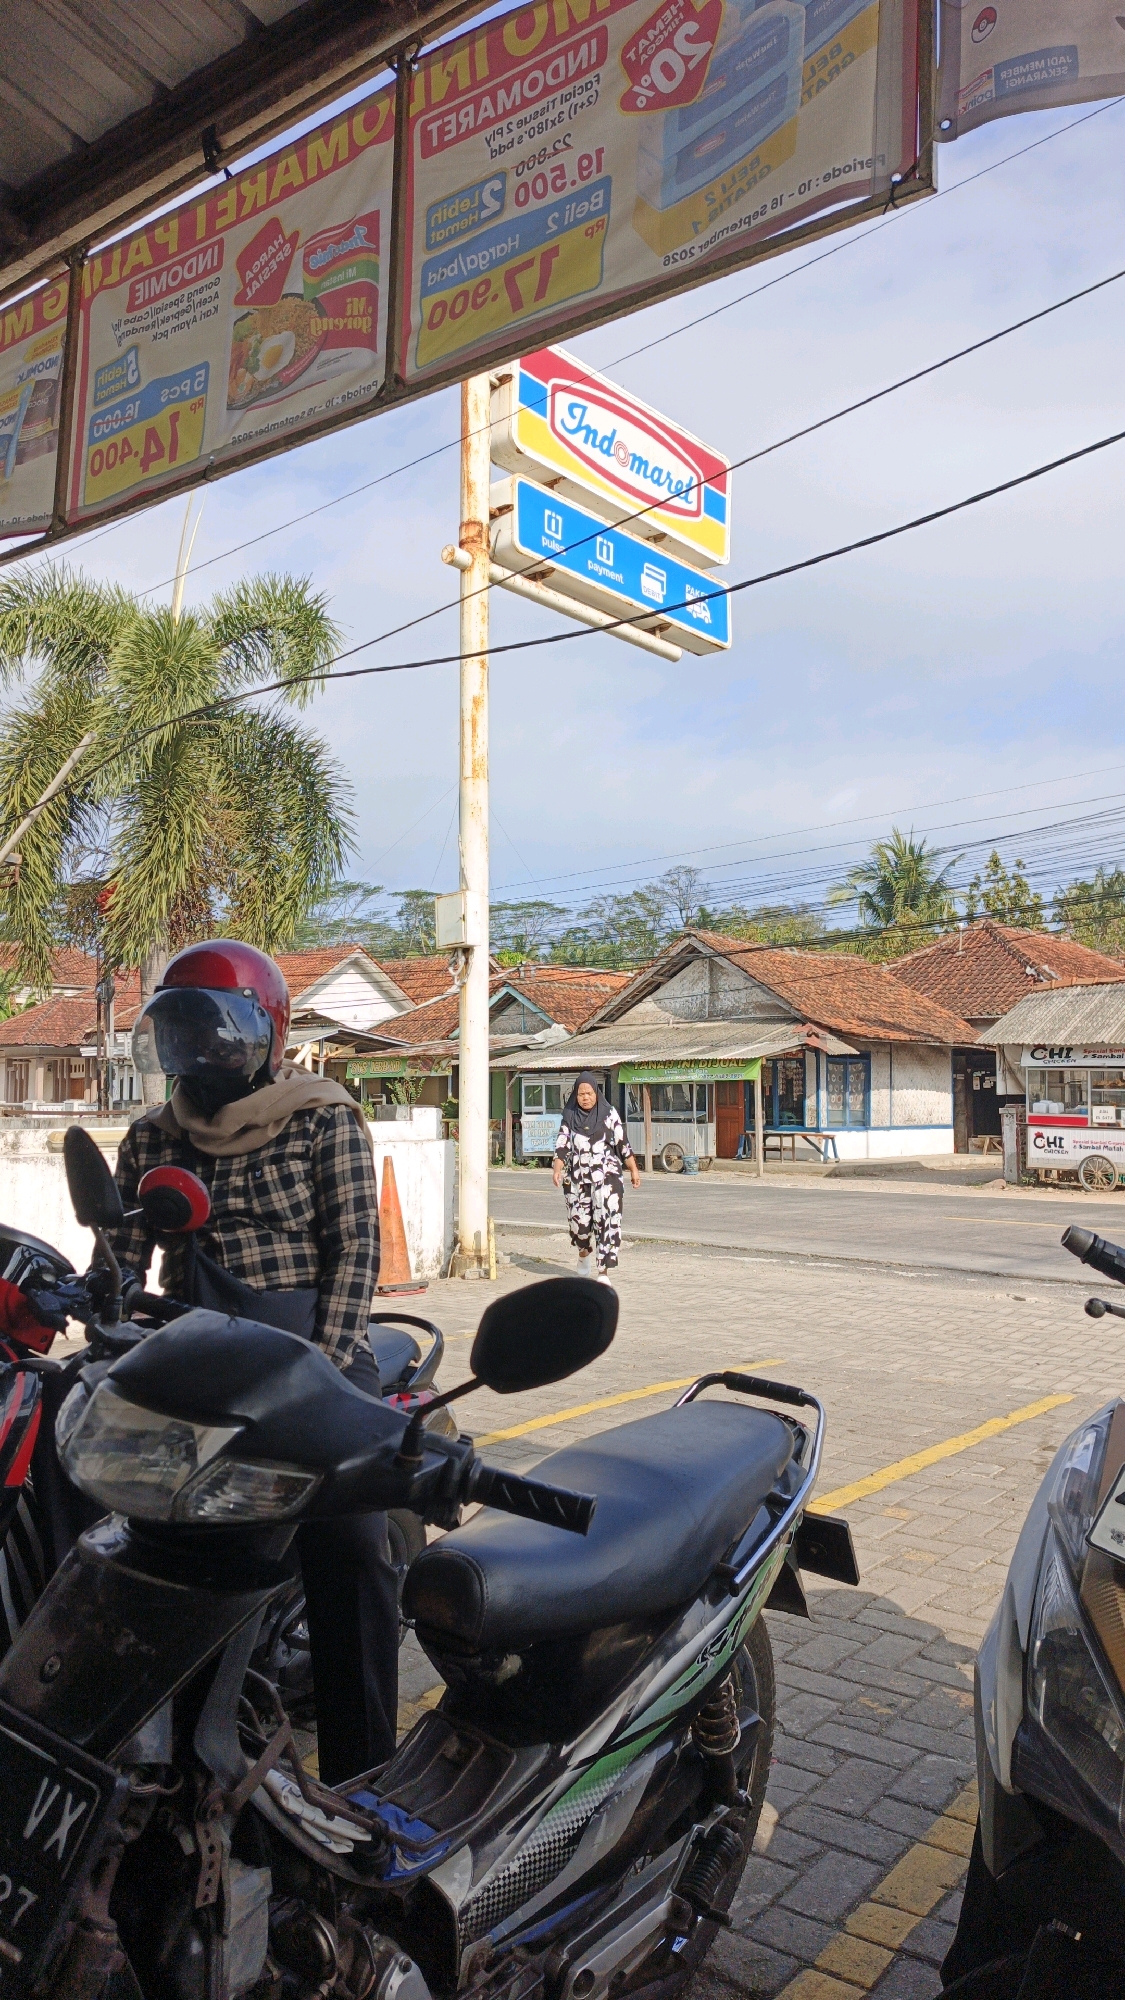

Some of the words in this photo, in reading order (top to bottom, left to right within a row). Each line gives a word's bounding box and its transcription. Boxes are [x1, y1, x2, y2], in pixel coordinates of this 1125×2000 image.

[560, 402, 694, 506] Indomaret
[541, 535, 567, 557] pulsa
[588, 559, 625, 585] payment
[643, 585, 661, 600] DEBIT
[698, 1058, 747, 1068] DIJUAL
[22, 1776, 88, 1861] VX
